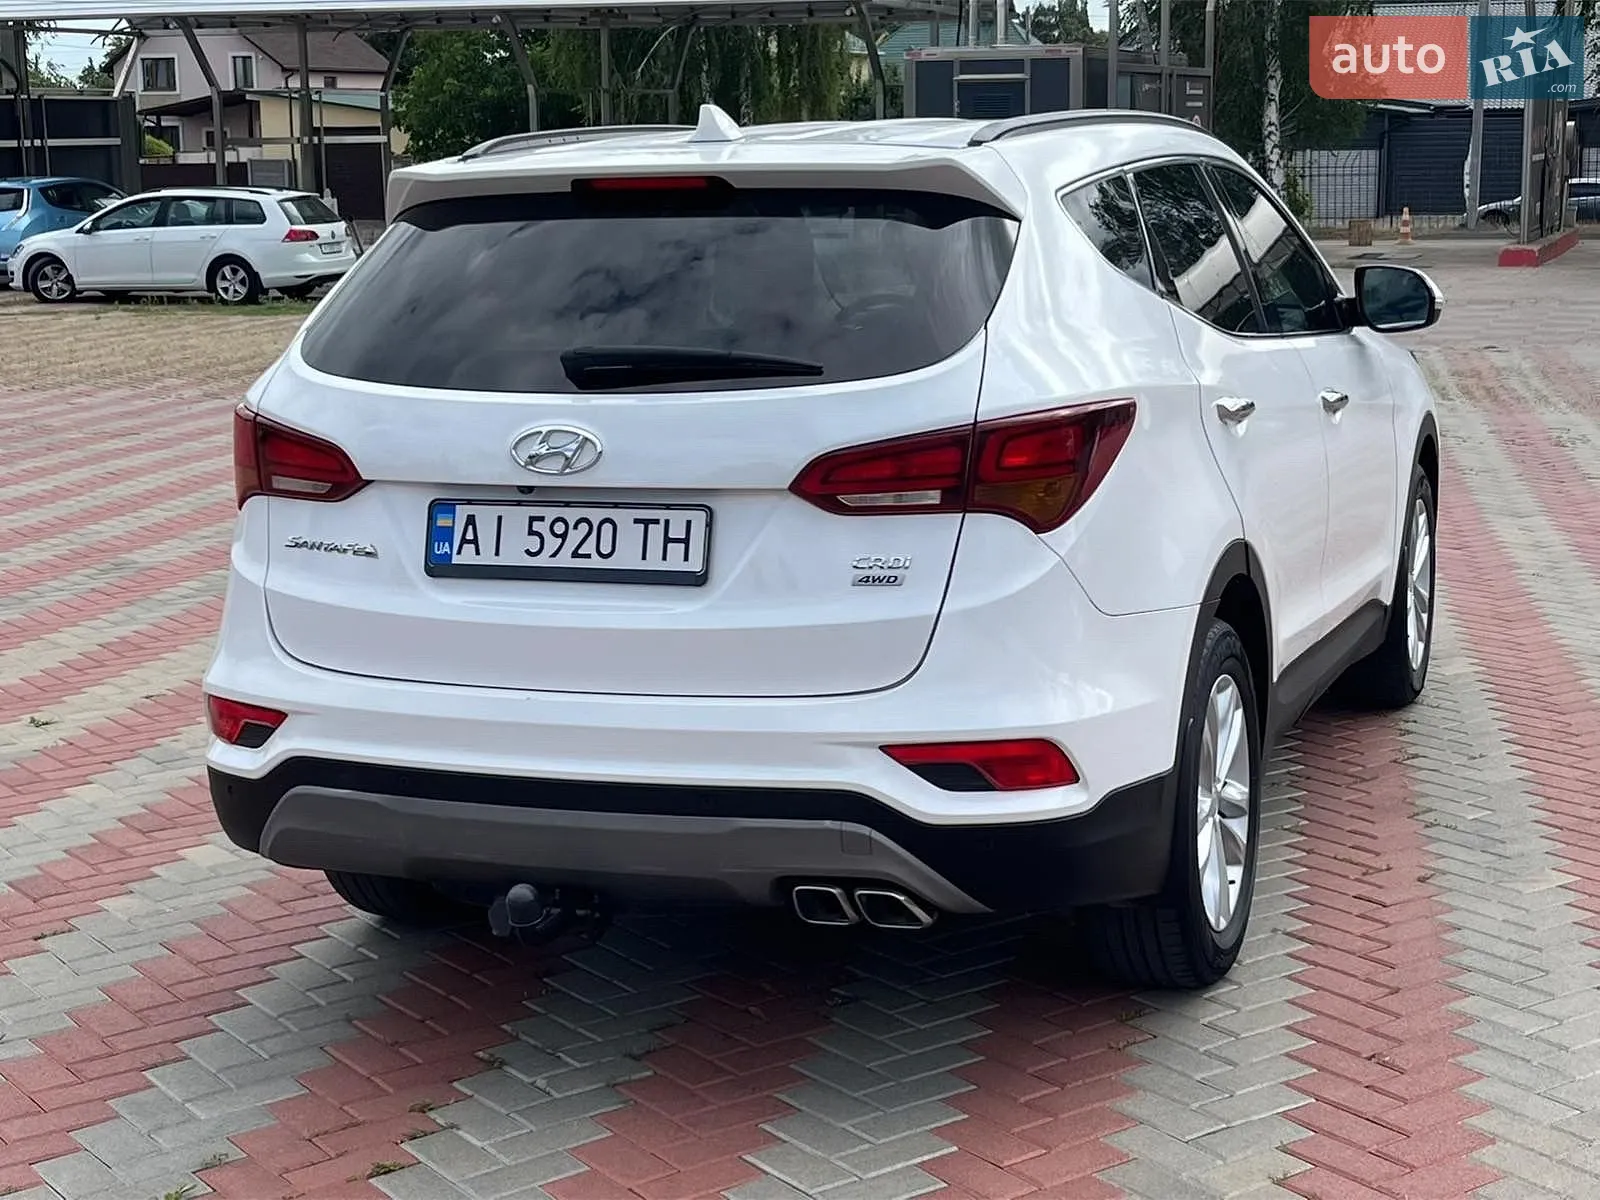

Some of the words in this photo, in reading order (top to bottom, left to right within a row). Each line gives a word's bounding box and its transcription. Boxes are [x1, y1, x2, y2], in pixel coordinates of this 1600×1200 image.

[456, 514, 503, 557] AI
[523, 515, 618, 560] 5920
[633, 518, 693, 562] TH
[433, 541, 451, 555] UA
[857, 575, 899, 584] 4WD
